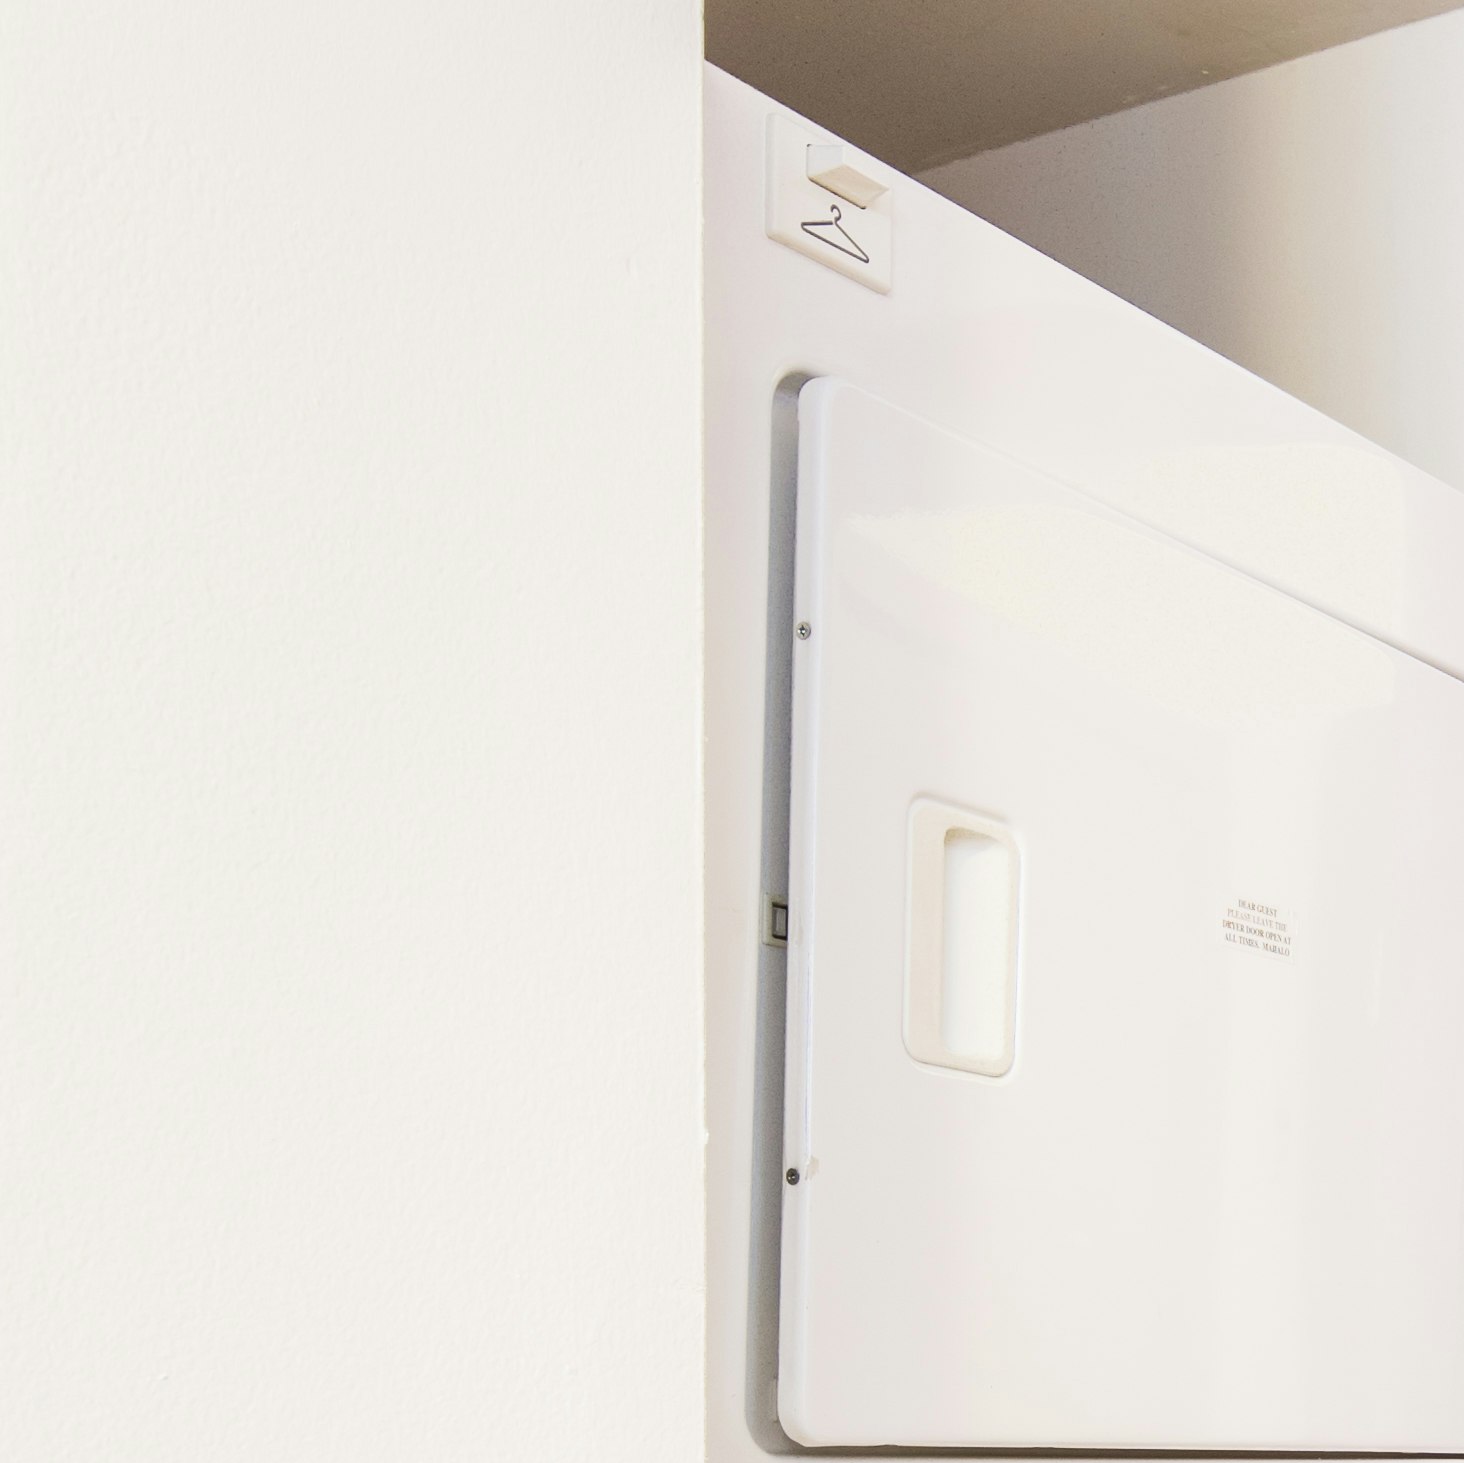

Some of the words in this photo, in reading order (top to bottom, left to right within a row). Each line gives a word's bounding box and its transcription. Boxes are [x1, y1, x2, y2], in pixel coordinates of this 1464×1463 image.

[1228, 908, 1250, 920] PLEASE
[1252, 915, 1273, 928] LEAVE
[1275, 922, 1286, 932] THE
[1238, 899, 1255, 910] DEAR
[1257, 904, 1277, 918] GUEST
[1222, 920, 1244, 933] DRYER
[1246, 926, 1264, 938] DOOR
[1266, 931, 1281, 942] OPEN
[1284, 937, 1291, 945] AT
[1225, 932, 1236, 943] ALL
[1263, 942, 1290, 956] MAHALO
